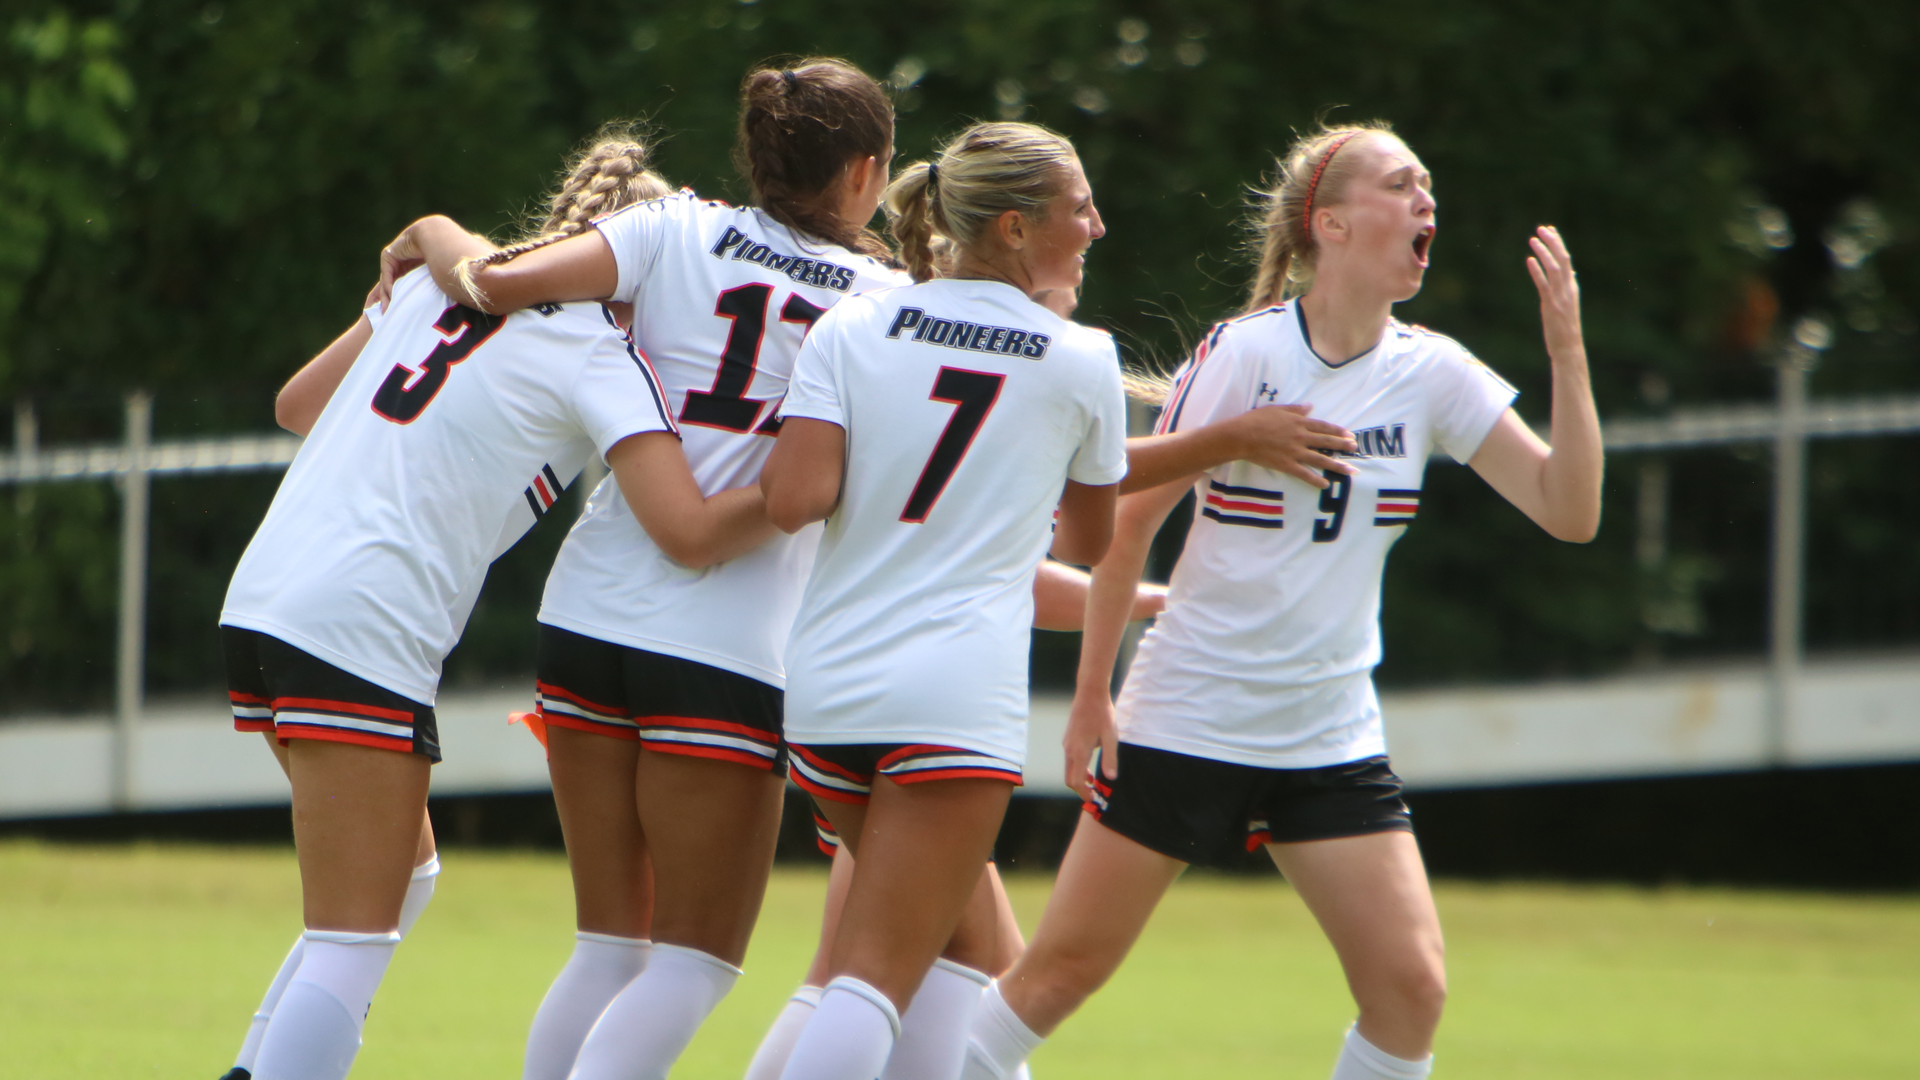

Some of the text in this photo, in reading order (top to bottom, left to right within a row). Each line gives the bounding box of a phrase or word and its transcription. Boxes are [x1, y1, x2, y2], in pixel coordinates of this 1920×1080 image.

[371, 302, 508, 426] 3
[885, 306, 1051, 361] PIONEERS
[898, 365, 1007, 524] 7
[1312, 469, 1353, 543] 9
